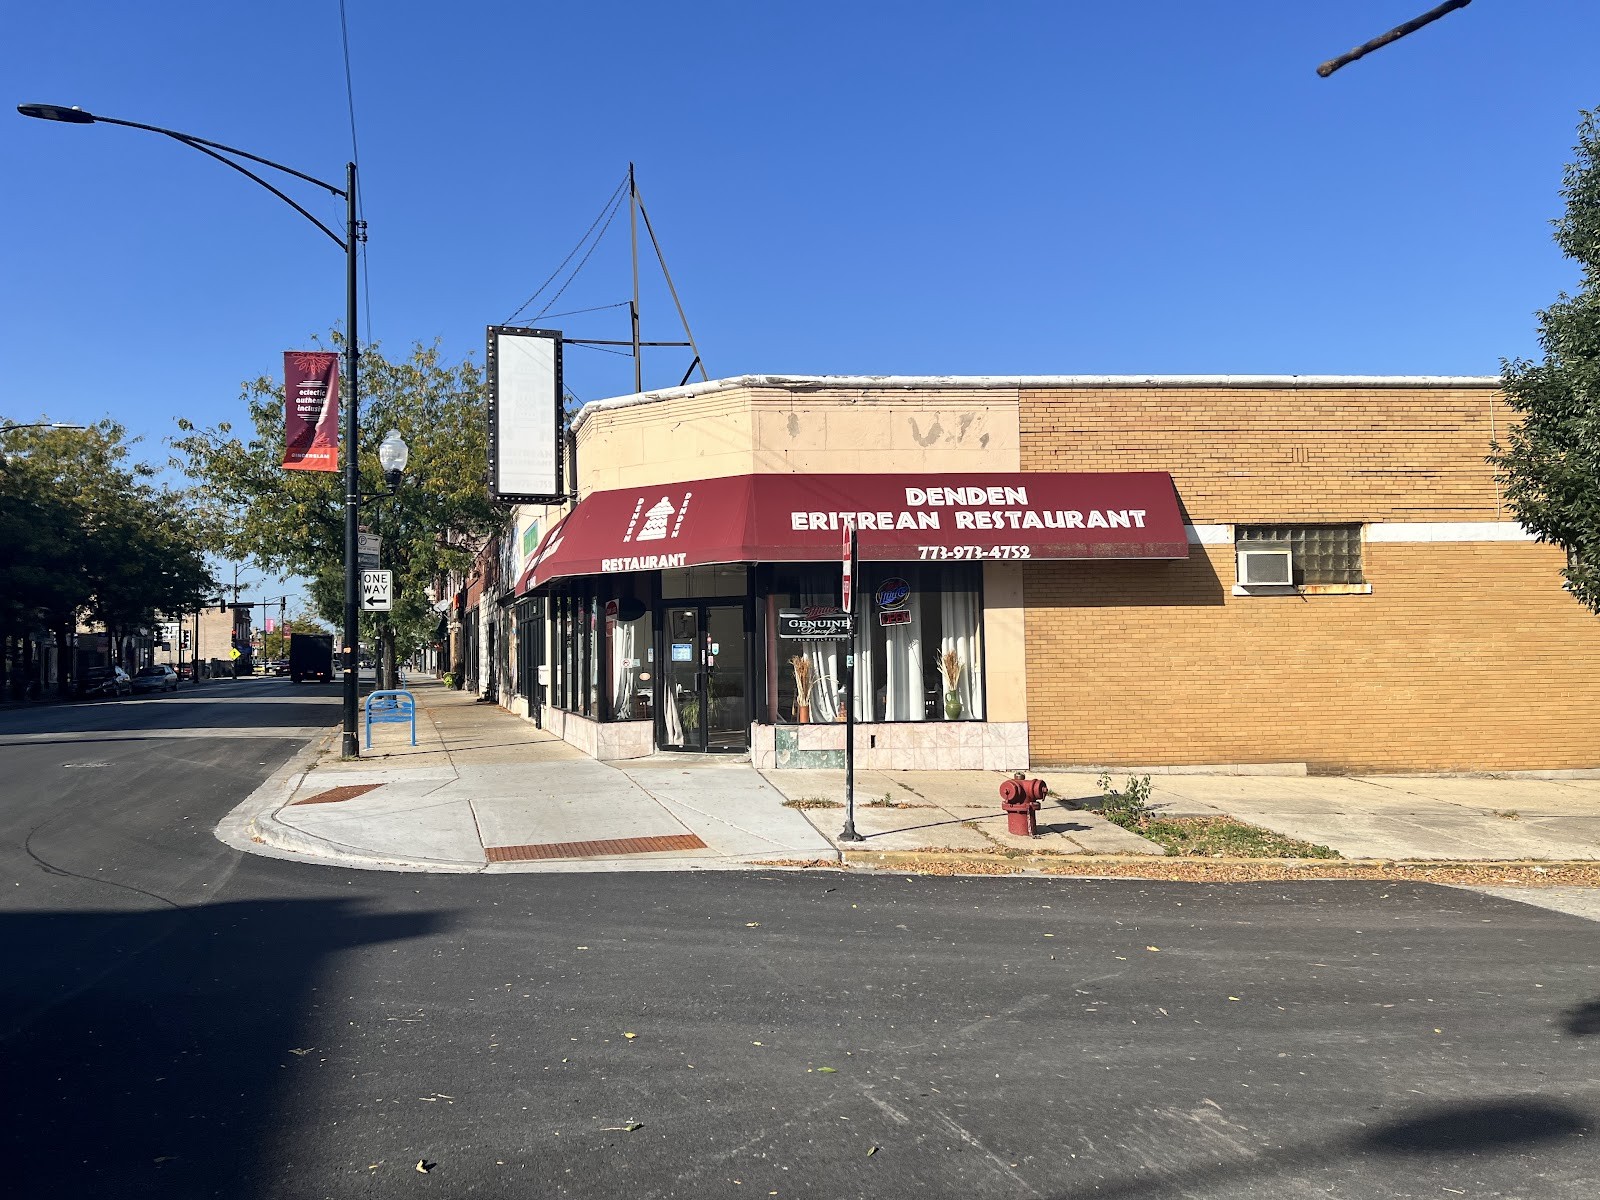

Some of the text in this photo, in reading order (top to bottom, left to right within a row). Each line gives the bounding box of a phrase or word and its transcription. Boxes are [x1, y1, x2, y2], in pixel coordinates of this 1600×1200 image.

[905, 487, 1029, 507] DENDEN
[622, 497, 645, 543] DENDEN
[670, 492, 693, 539] DENDEN
[790, 509, 1147, 531] ERITREAN RESTAURANT
[601, 552, 687, 572] RESTAURANT
[918, 545, 1032, 560] 773-973-4752
[363, 574, 388, 584] ONE
[363, 584, 388, 594] WAY
[788, 619, 848, 628] GENUINE
